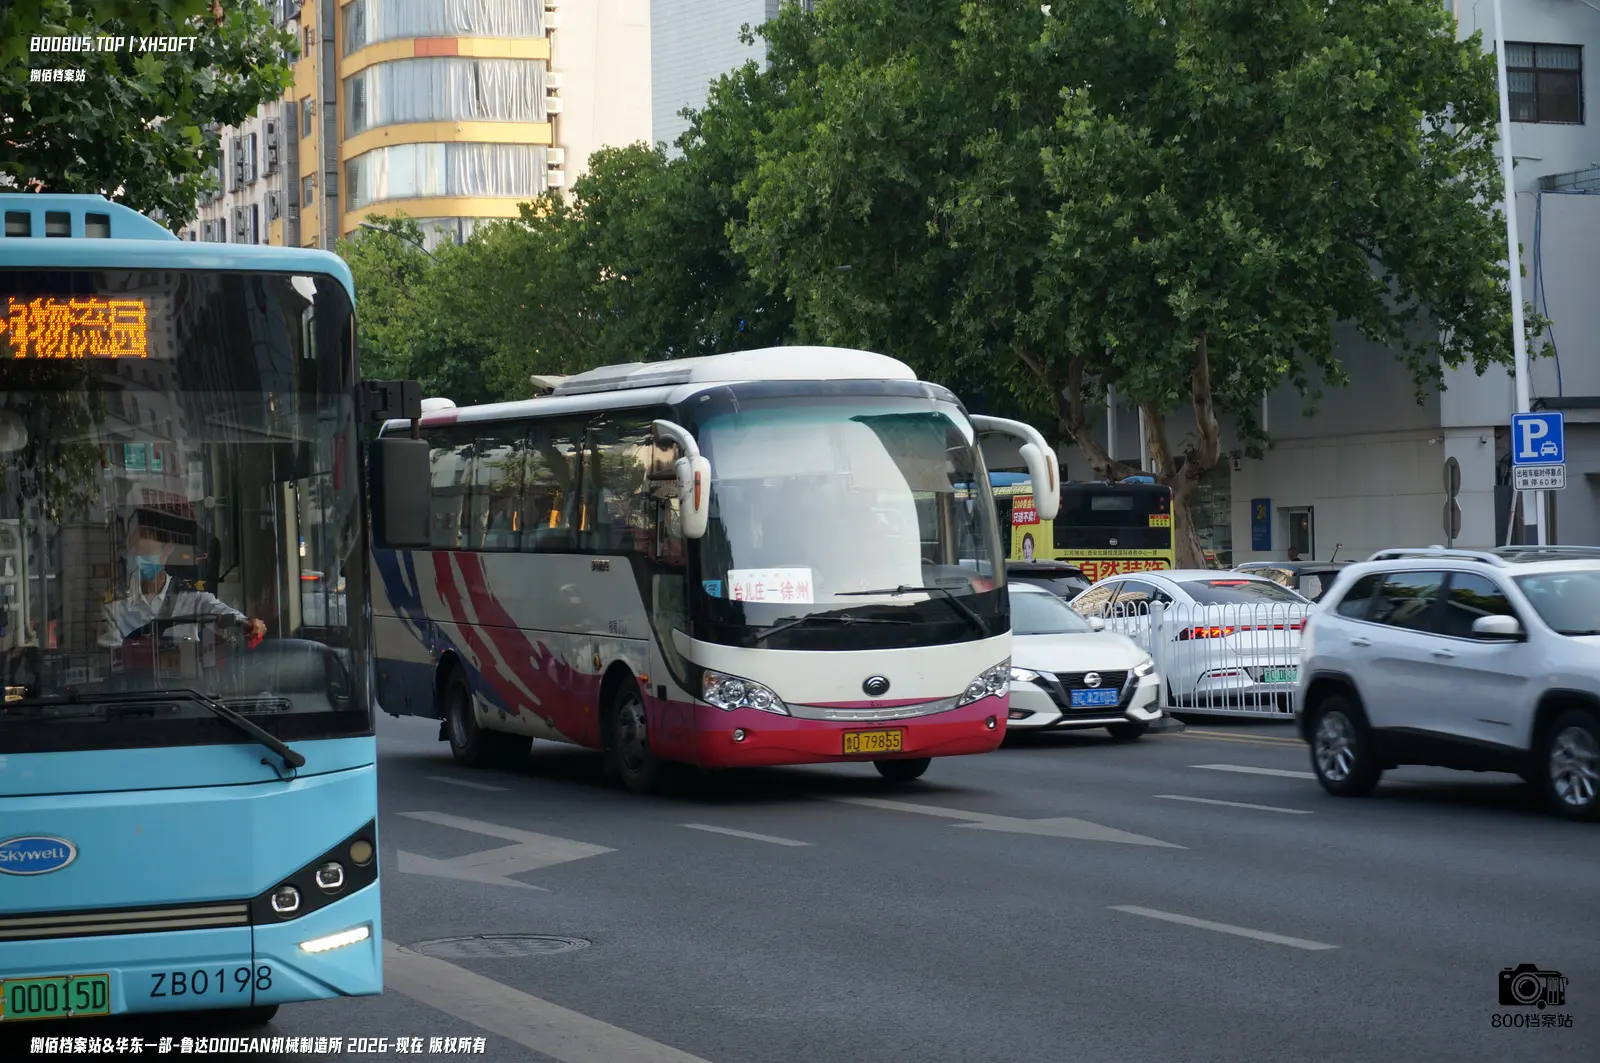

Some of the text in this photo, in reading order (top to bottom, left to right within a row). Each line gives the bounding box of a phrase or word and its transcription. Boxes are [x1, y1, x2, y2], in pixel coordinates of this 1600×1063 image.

[1518, 418, 1548, 458] P
[1517, 468, 1562, 478] 出租车临时停靠点
[11, 980, 107, 1014] 00015D
[150, 965, 273, 998] ZB0198
